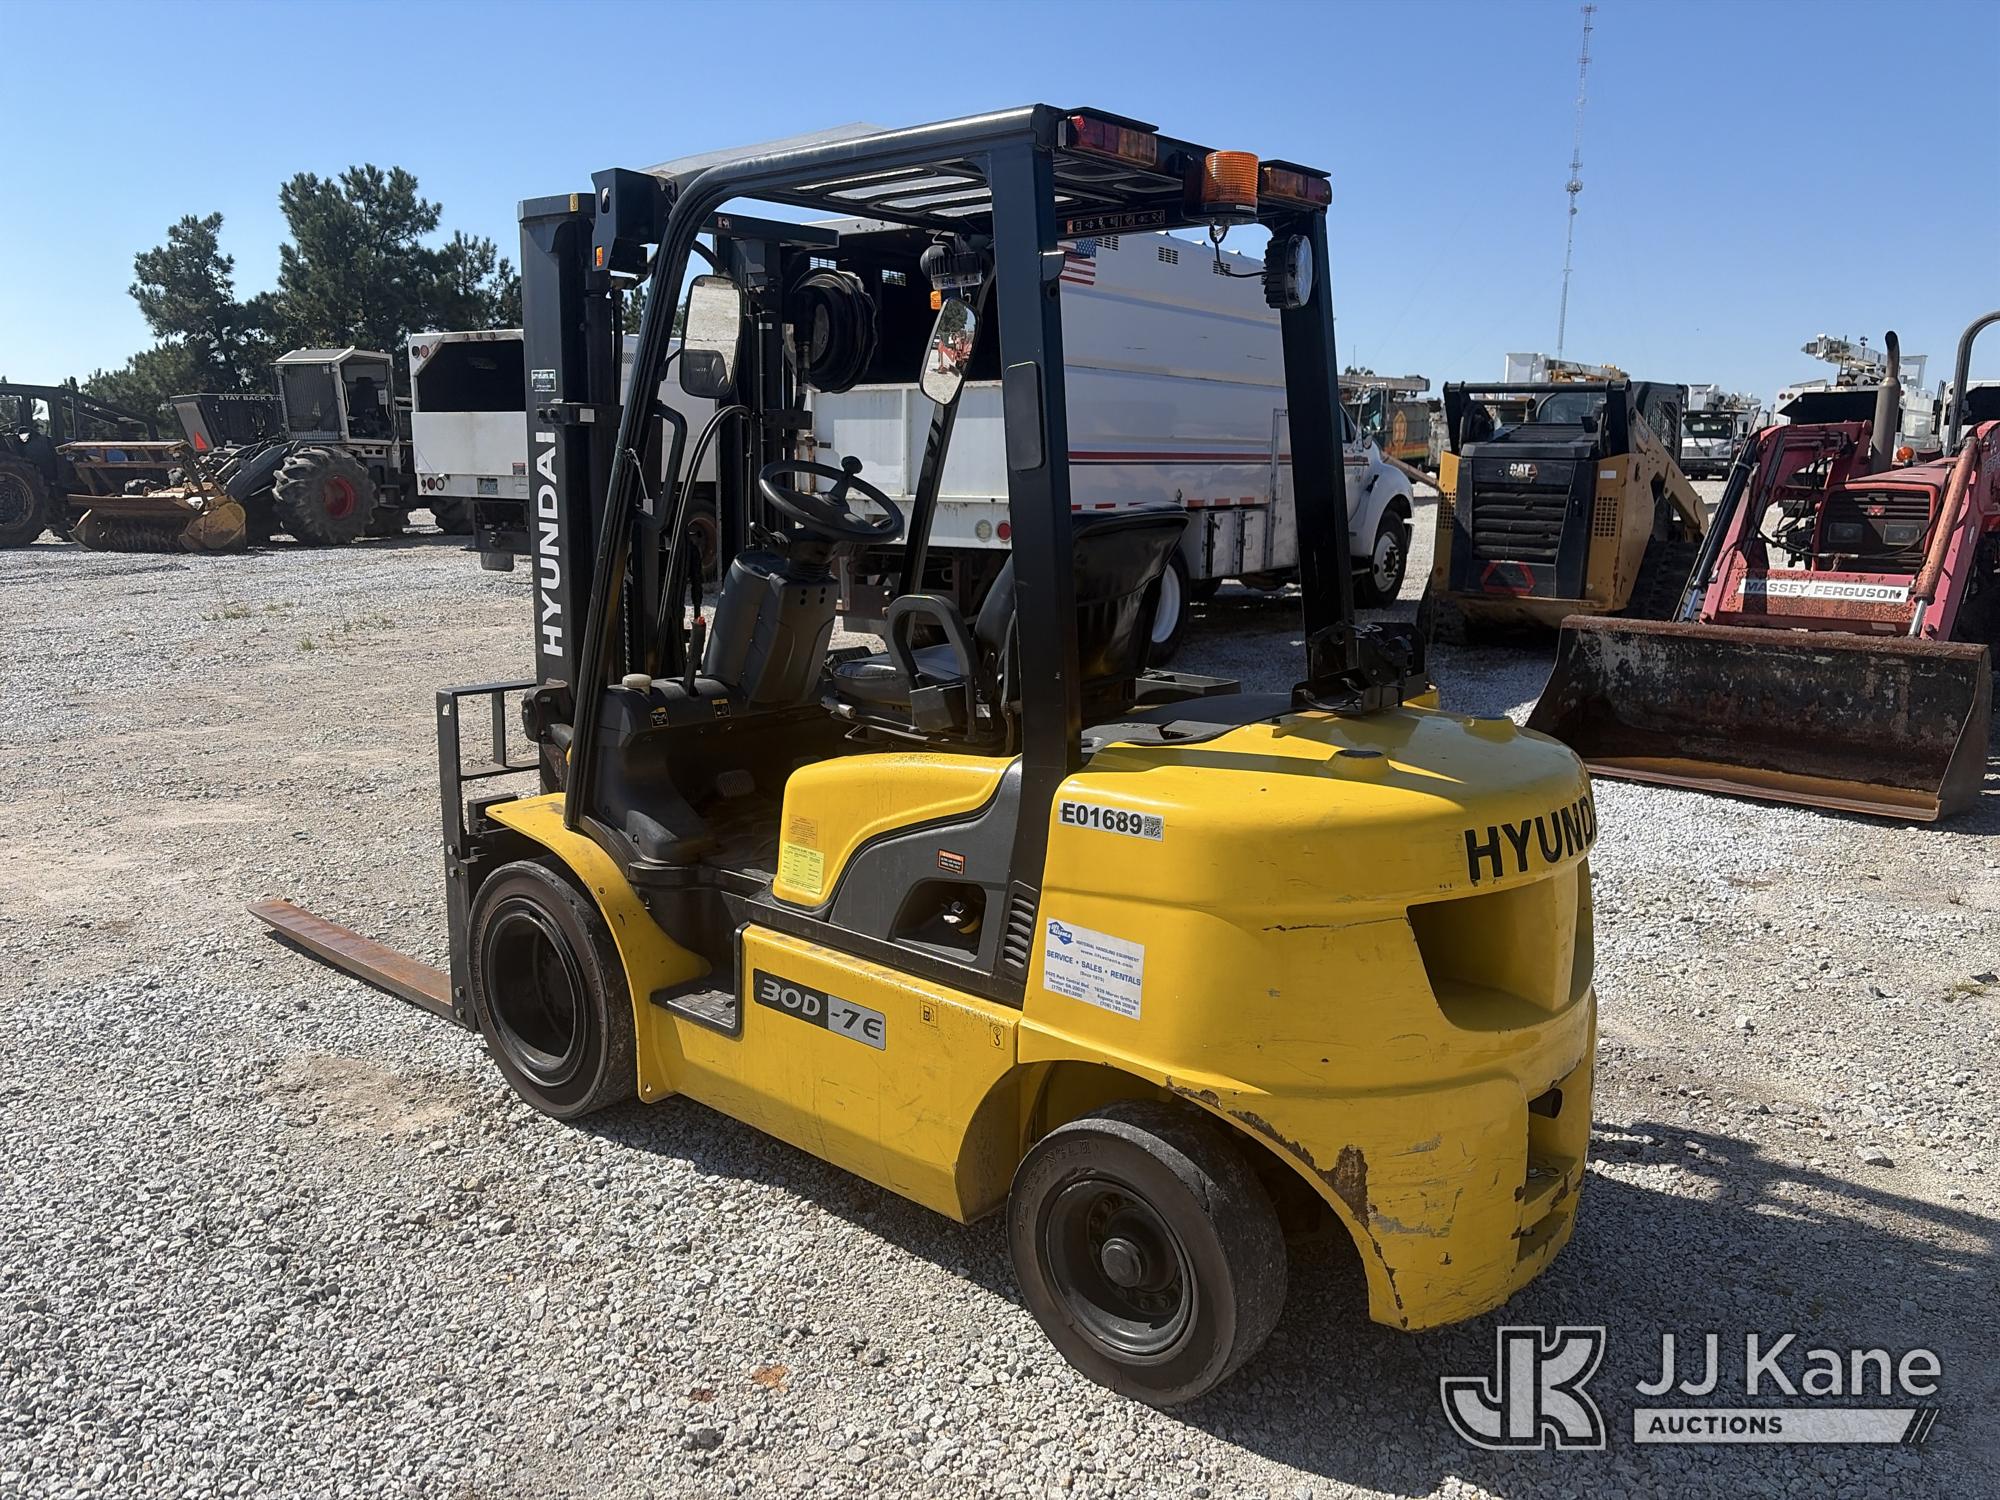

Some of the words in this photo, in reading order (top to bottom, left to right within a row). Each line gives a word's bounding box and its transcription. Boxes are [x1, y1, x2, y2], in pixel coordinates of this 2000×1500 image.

[536, 432, 563, 657] HYUNDAI
[1744, 581, 1809, 595] MASSEY
[1813, 585, 1902, 600] FERGUSON
[1062, 802, 1142, 835] E01689
[1464, 796, 1597, 882] HYUND
[1046, 949, 1072, 964] SERVICE
[1081, 960, 1102, 973] SALES
[1110, 970, 1140, 985] RENTALS
